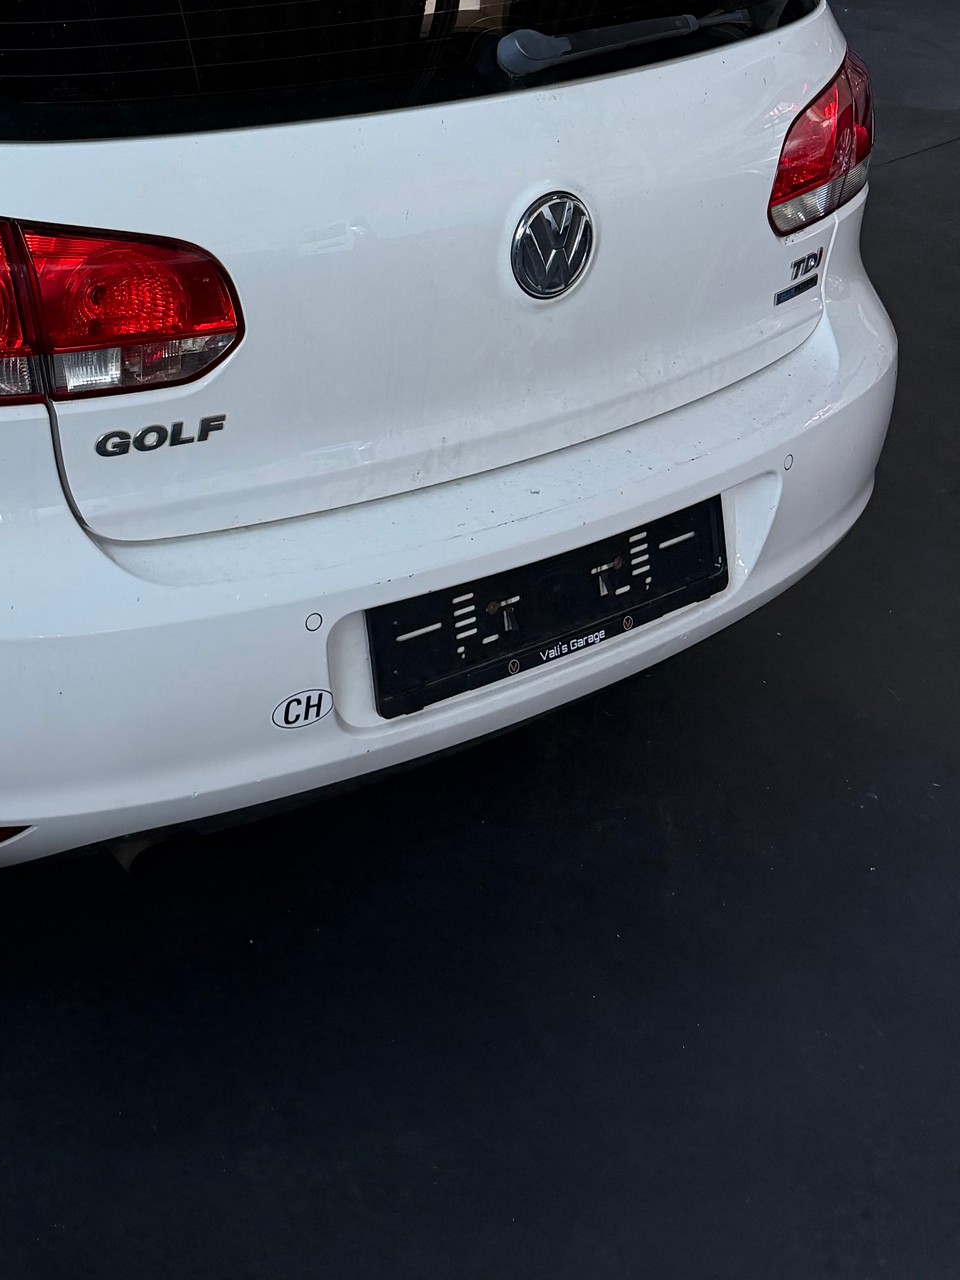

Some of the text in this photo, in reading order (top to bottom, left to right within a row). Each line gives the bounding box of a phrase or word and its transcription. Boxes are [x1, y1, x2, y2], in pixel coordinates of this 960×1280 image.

[790, 246, 823, 281] TDI
[94, 414, 227, 457] GOLF
[540, 629, 606, 660] Vali's Garage
[284, 693, 323, 725] CH
